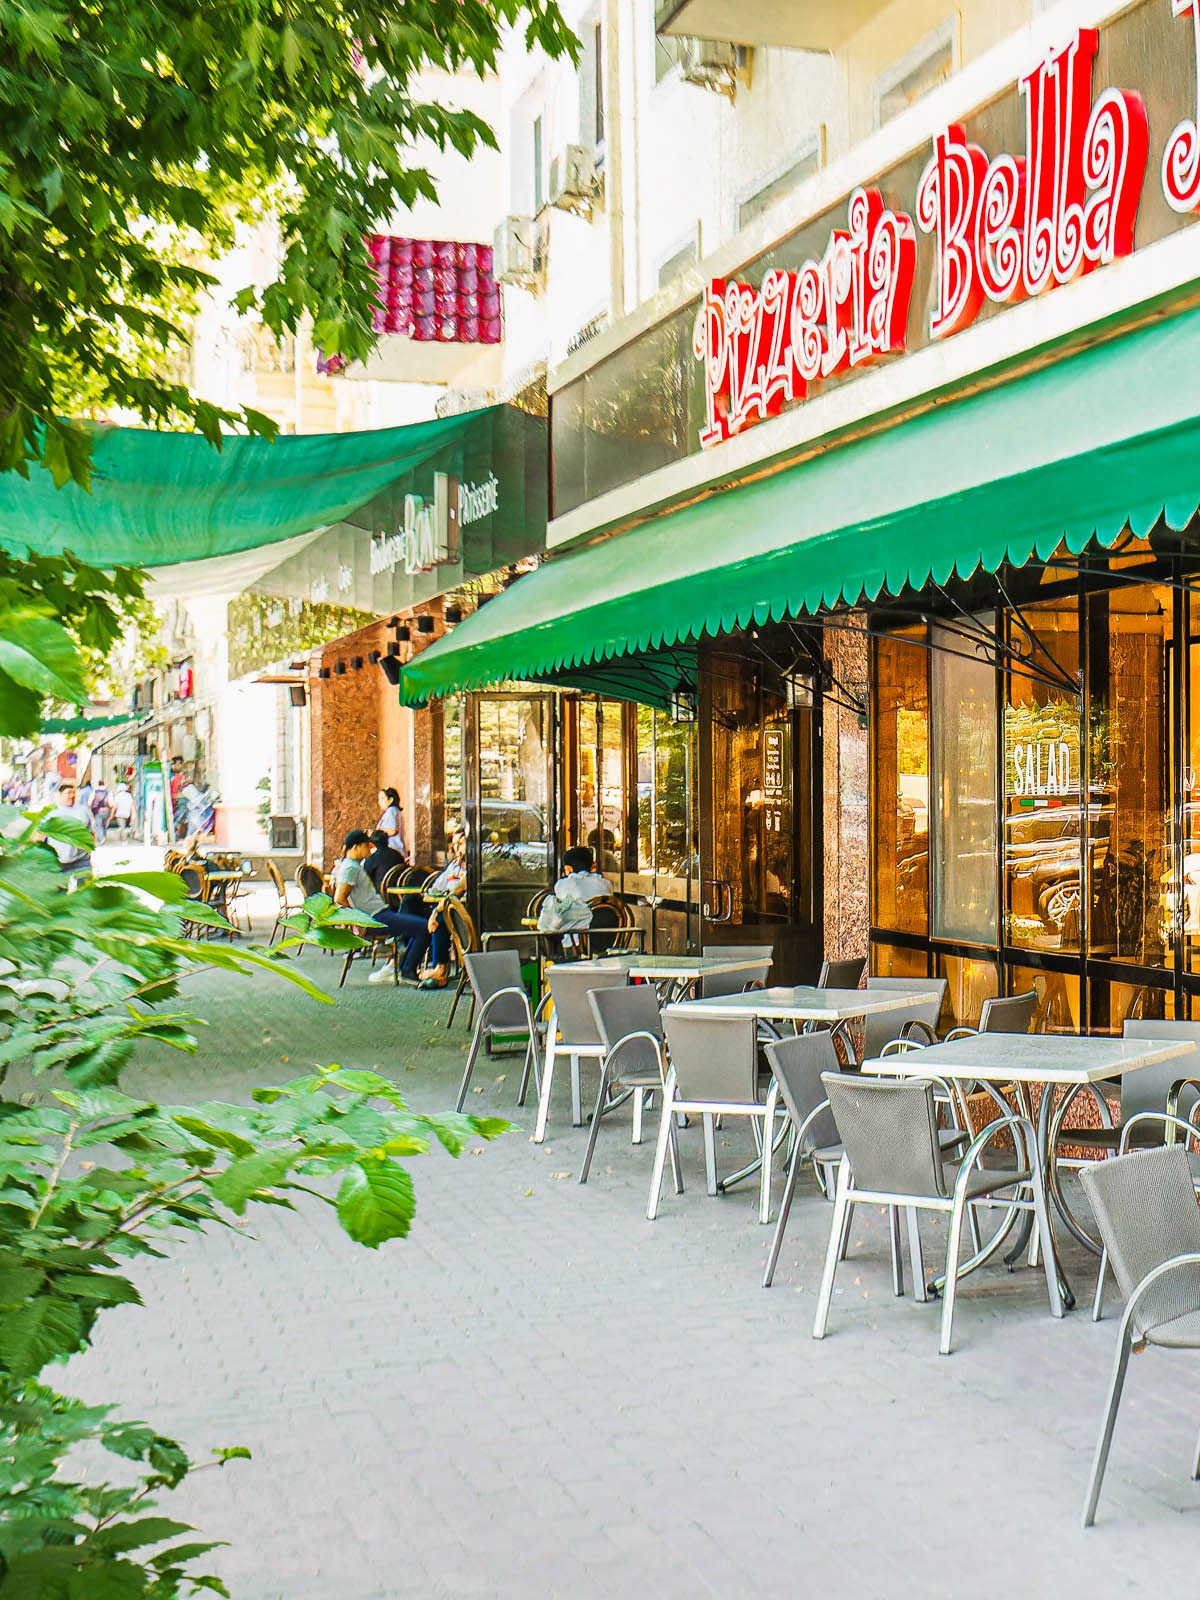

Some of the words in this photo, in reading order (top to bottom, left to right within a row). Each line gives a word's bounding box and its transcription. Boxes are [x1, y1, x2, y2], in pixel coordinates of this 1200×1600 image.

[692, 185, 914, 449] Pizzeria
[916, 28, 1146, 339] Bella
[1013, 742, 1070, 796] SALAD
